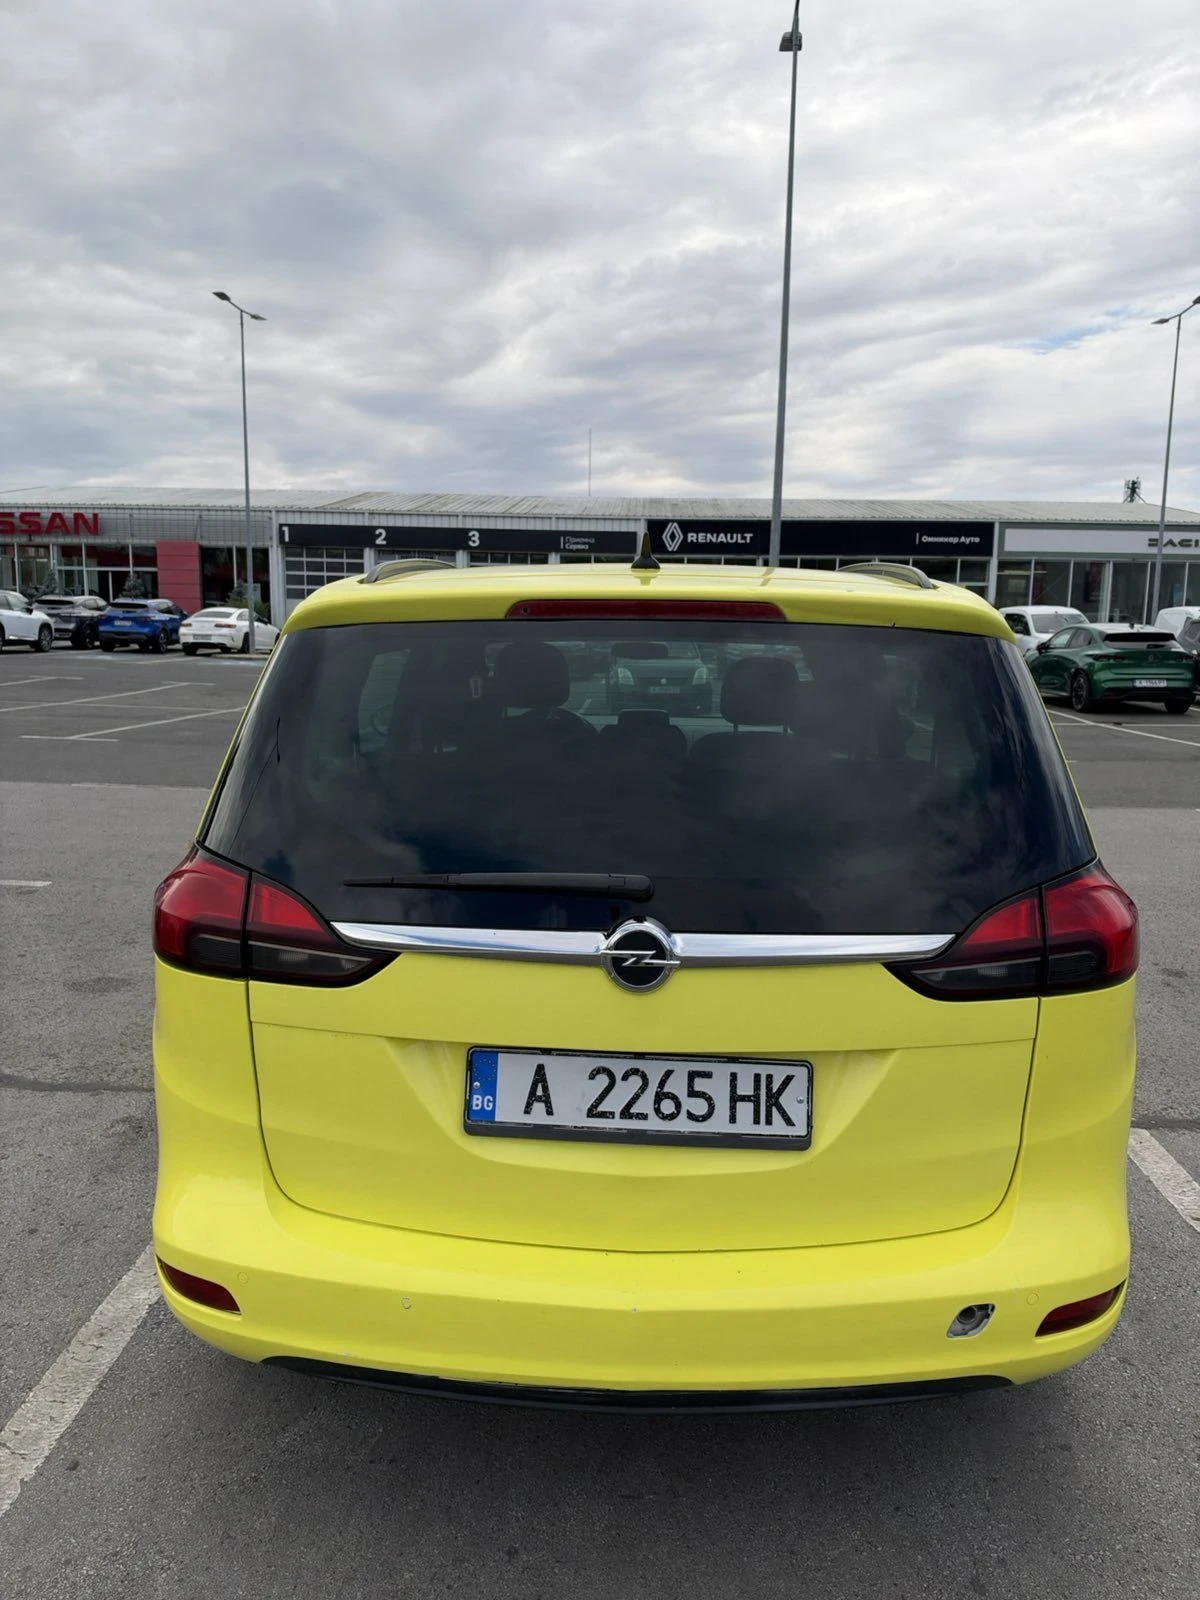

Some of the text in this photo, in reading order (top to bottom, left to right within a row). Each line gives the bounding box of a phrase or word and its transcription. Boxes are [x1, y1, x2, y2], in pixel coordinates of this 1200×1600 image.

[282, 526, 290, 542] 1
[375, 528, 387, 545] 2
[468, 531, 480, 547] 3
[687, 532, 754, 544] RENAULT
[960, 535, 981, 544] Ауто
[472, 1095, 494, 1111] BG
[523, 1063, 796, 1127] A 2265 HK
